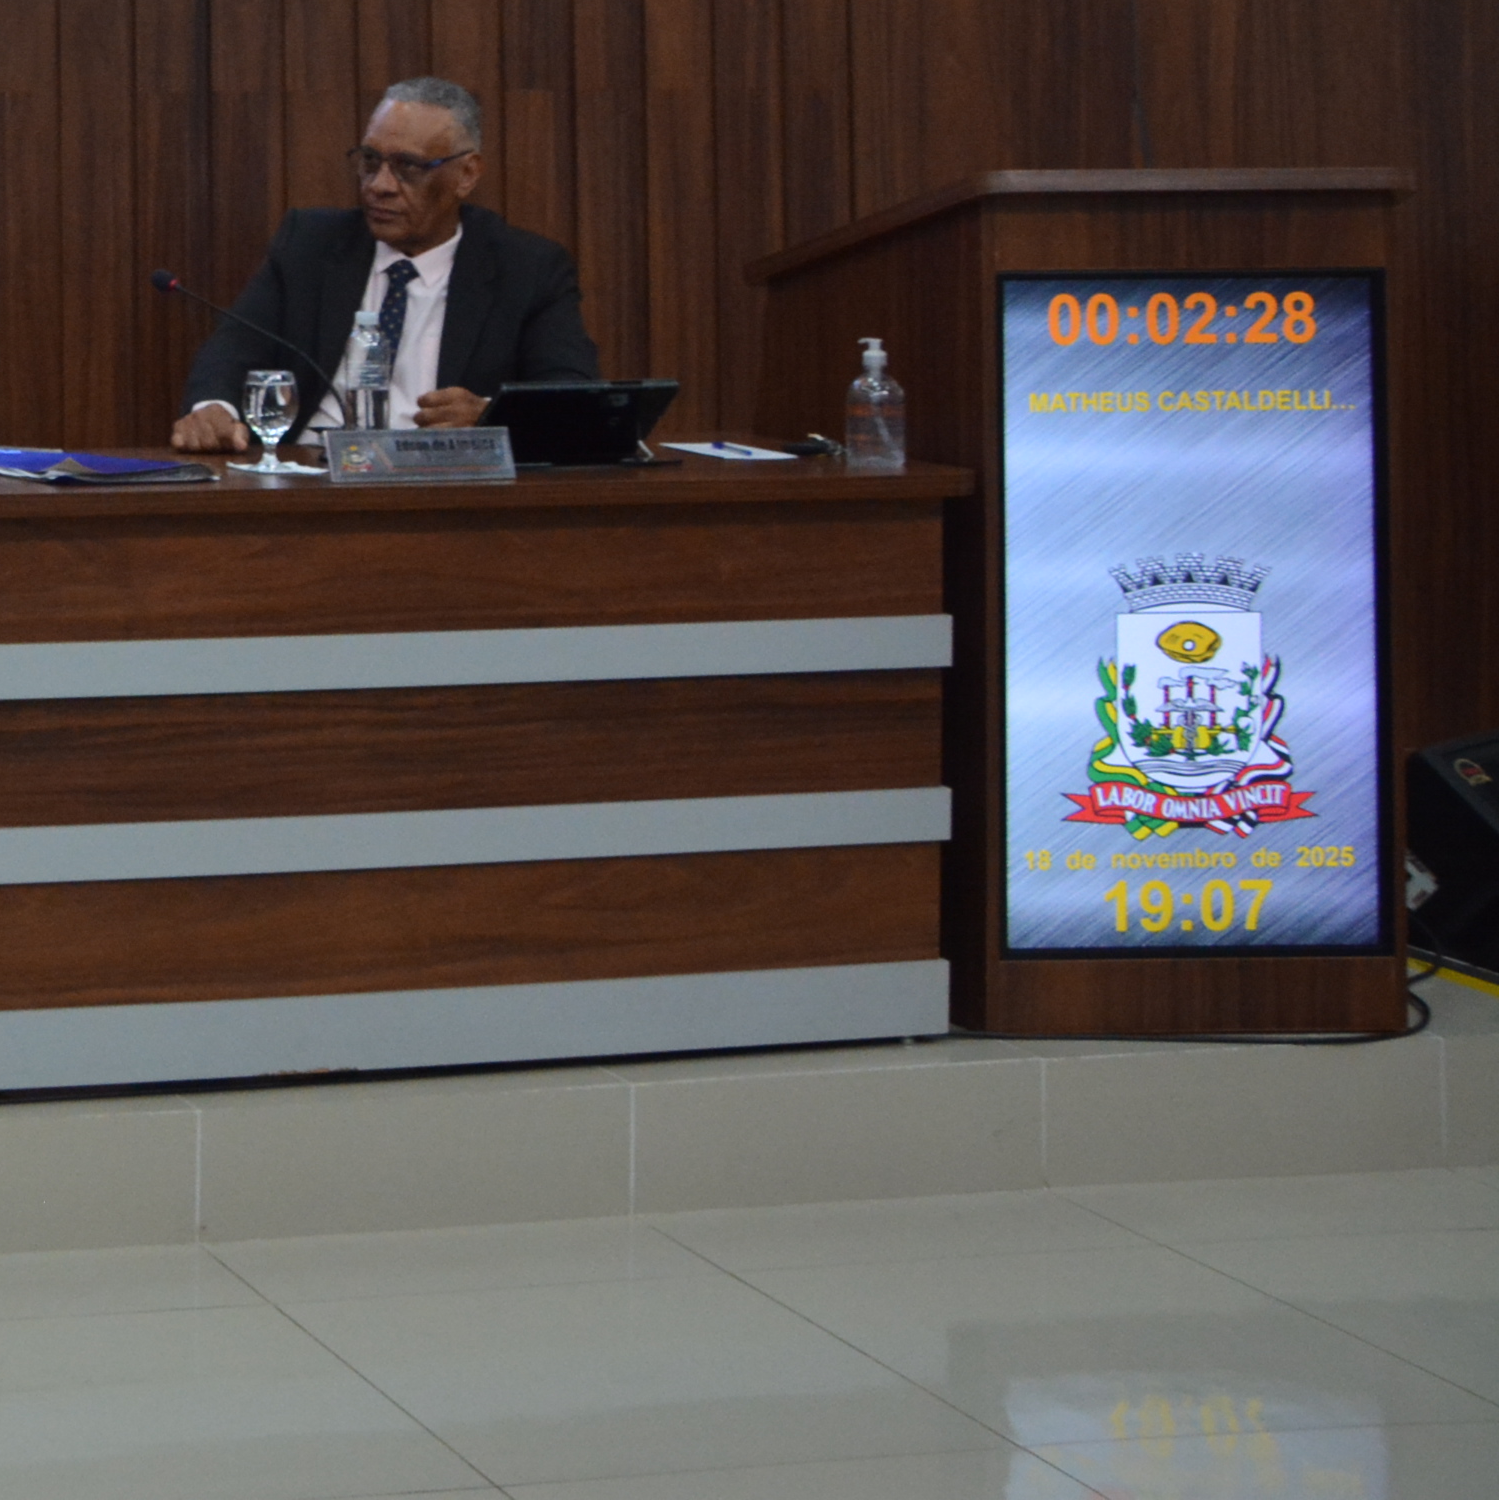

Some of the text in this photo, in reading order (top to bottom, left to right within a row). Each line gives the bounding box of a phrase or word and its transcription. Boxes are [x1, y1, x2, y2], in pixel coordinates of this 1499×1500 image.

[1047, 291, 1317, 346] 00:02:28
[1029, 392, 1151, 413] MATHEUS
[1095, 784, 1286, 820] LABOR OMNIA VINCIT
[1024, 846, 1355, 870] 18 de novembro de 2025
[1104, 880, 1273, 932] 19:07
